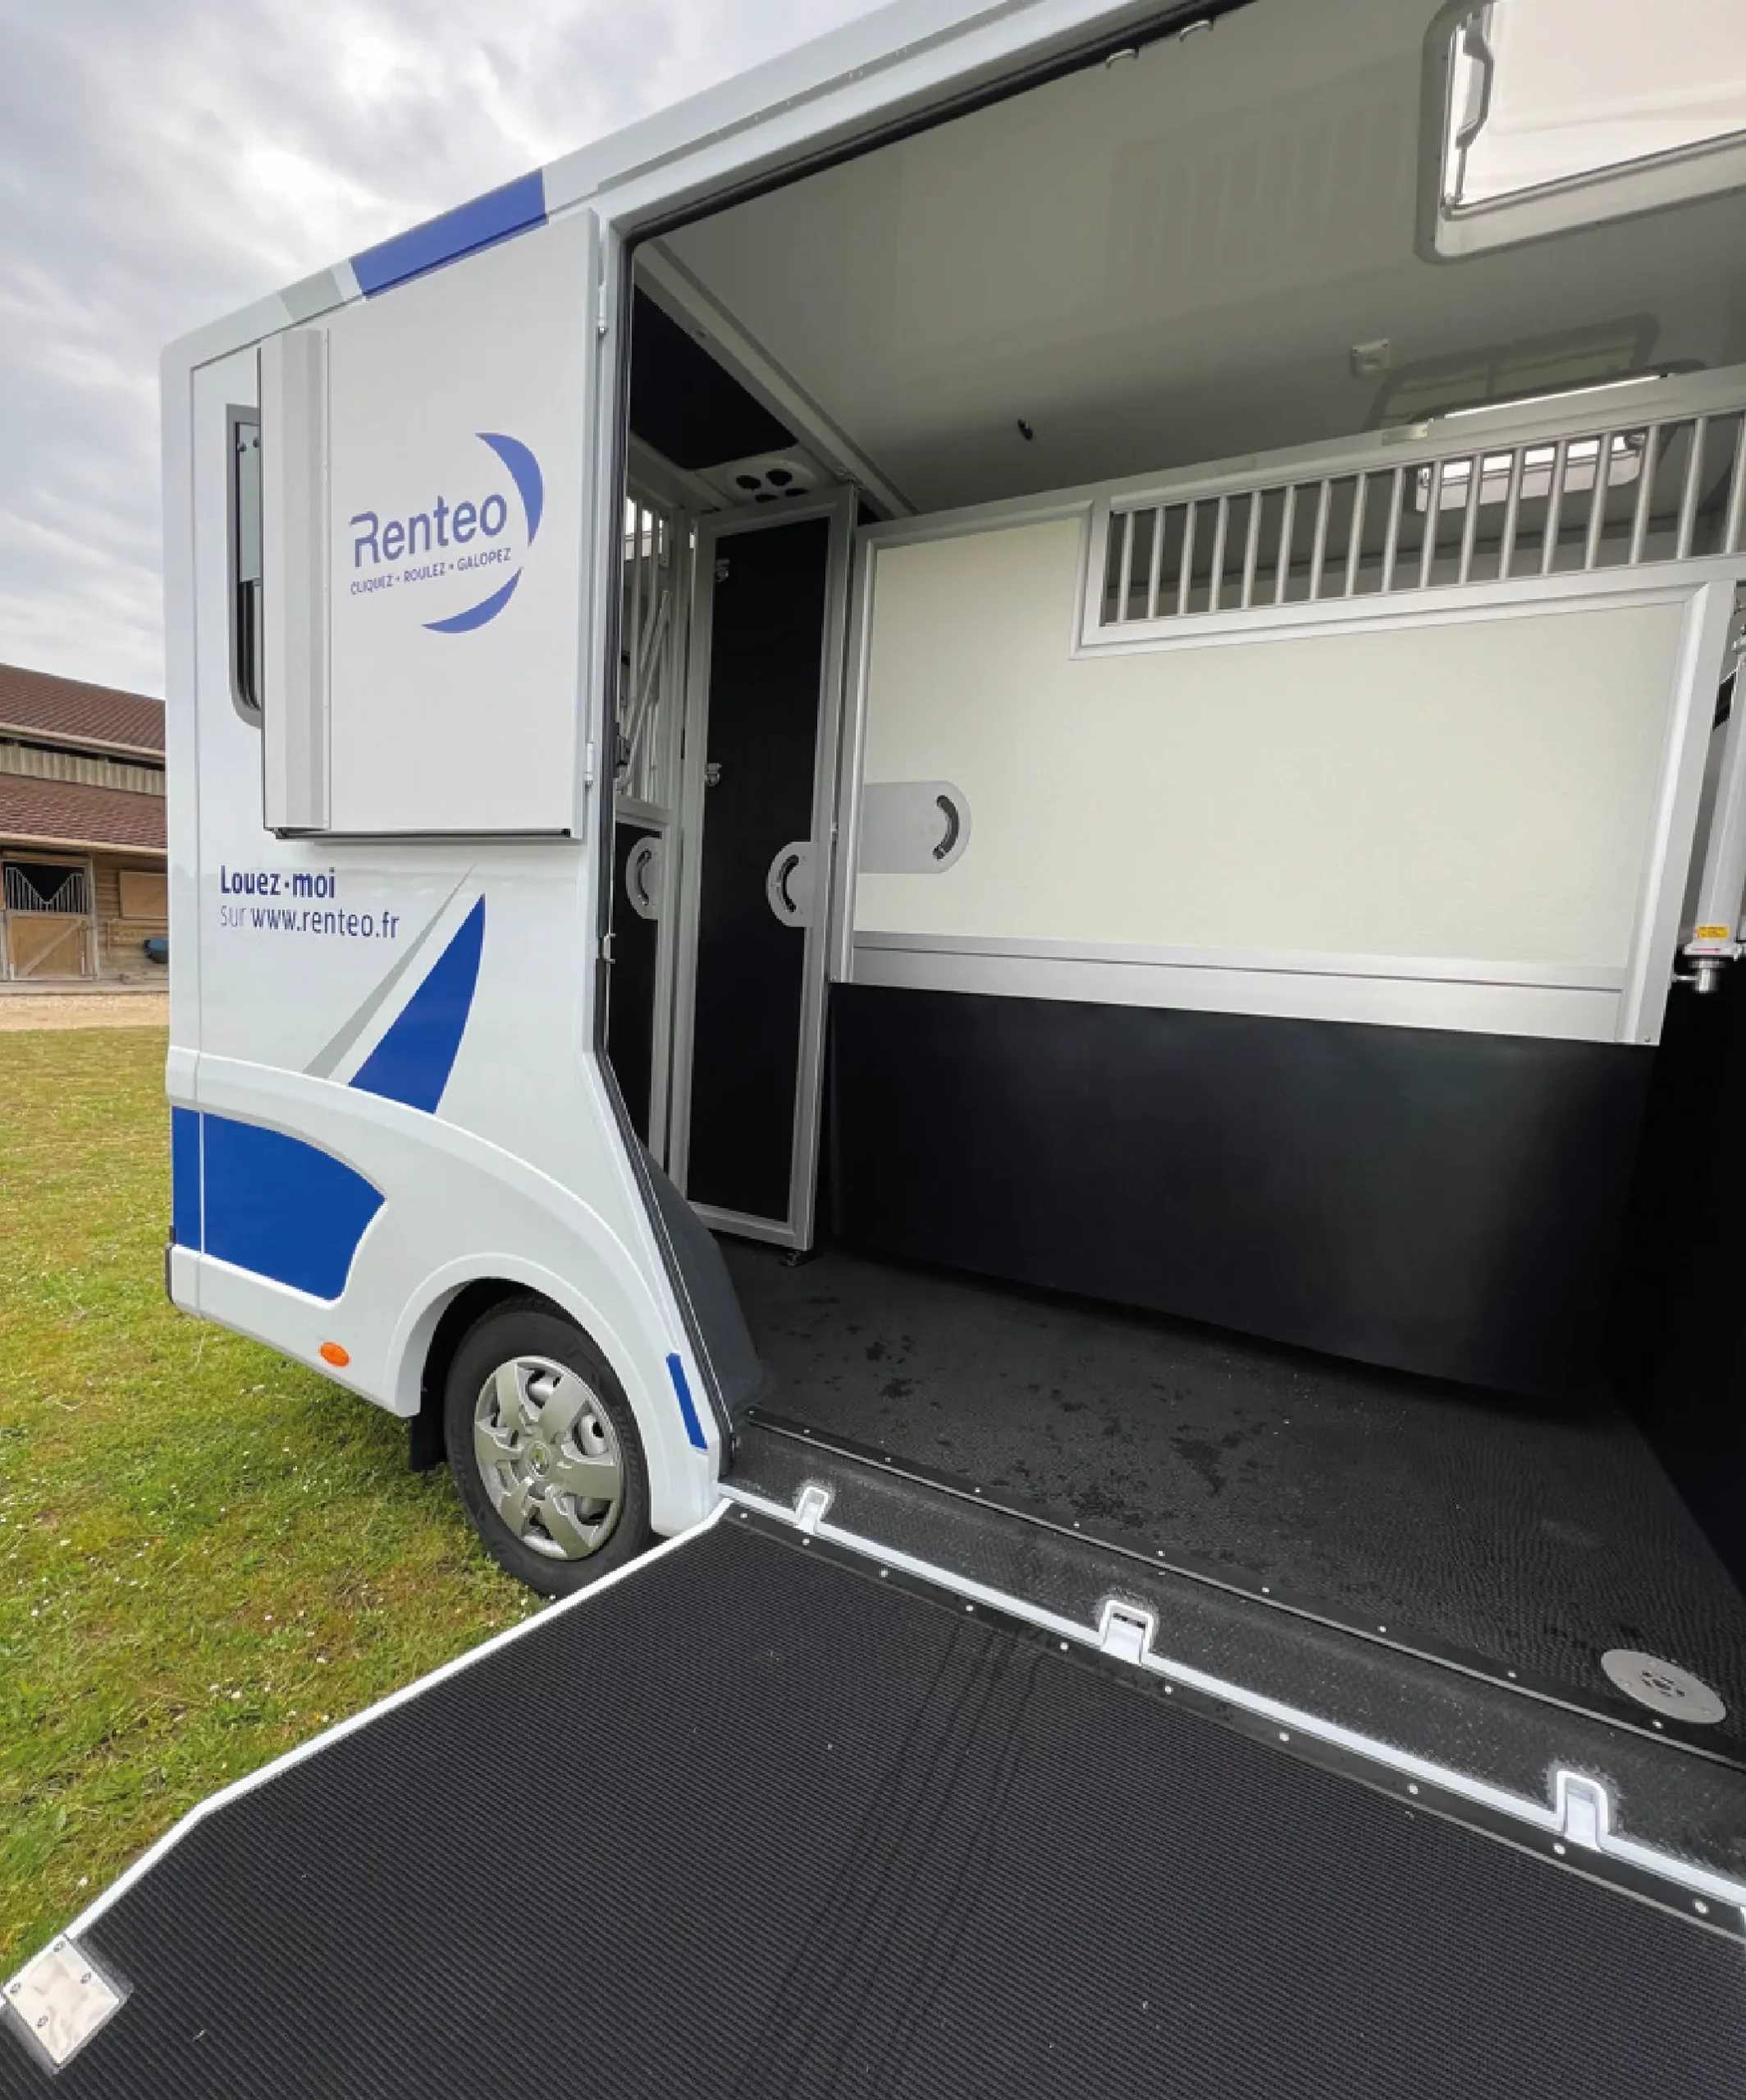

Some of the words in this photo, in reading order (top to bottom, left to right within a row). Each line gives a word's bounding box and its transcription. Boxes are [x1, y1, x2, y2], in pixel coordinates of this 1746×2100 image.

[350, 494, 507, 568] Renteo
[350, 575, 394, 595] CLIQUEZ
[404, 563, 445, 582] ROULEZ
[457, 548, 511, 571] GALOPEZ
[250, 907, 400, 938] www.renteo.fr
